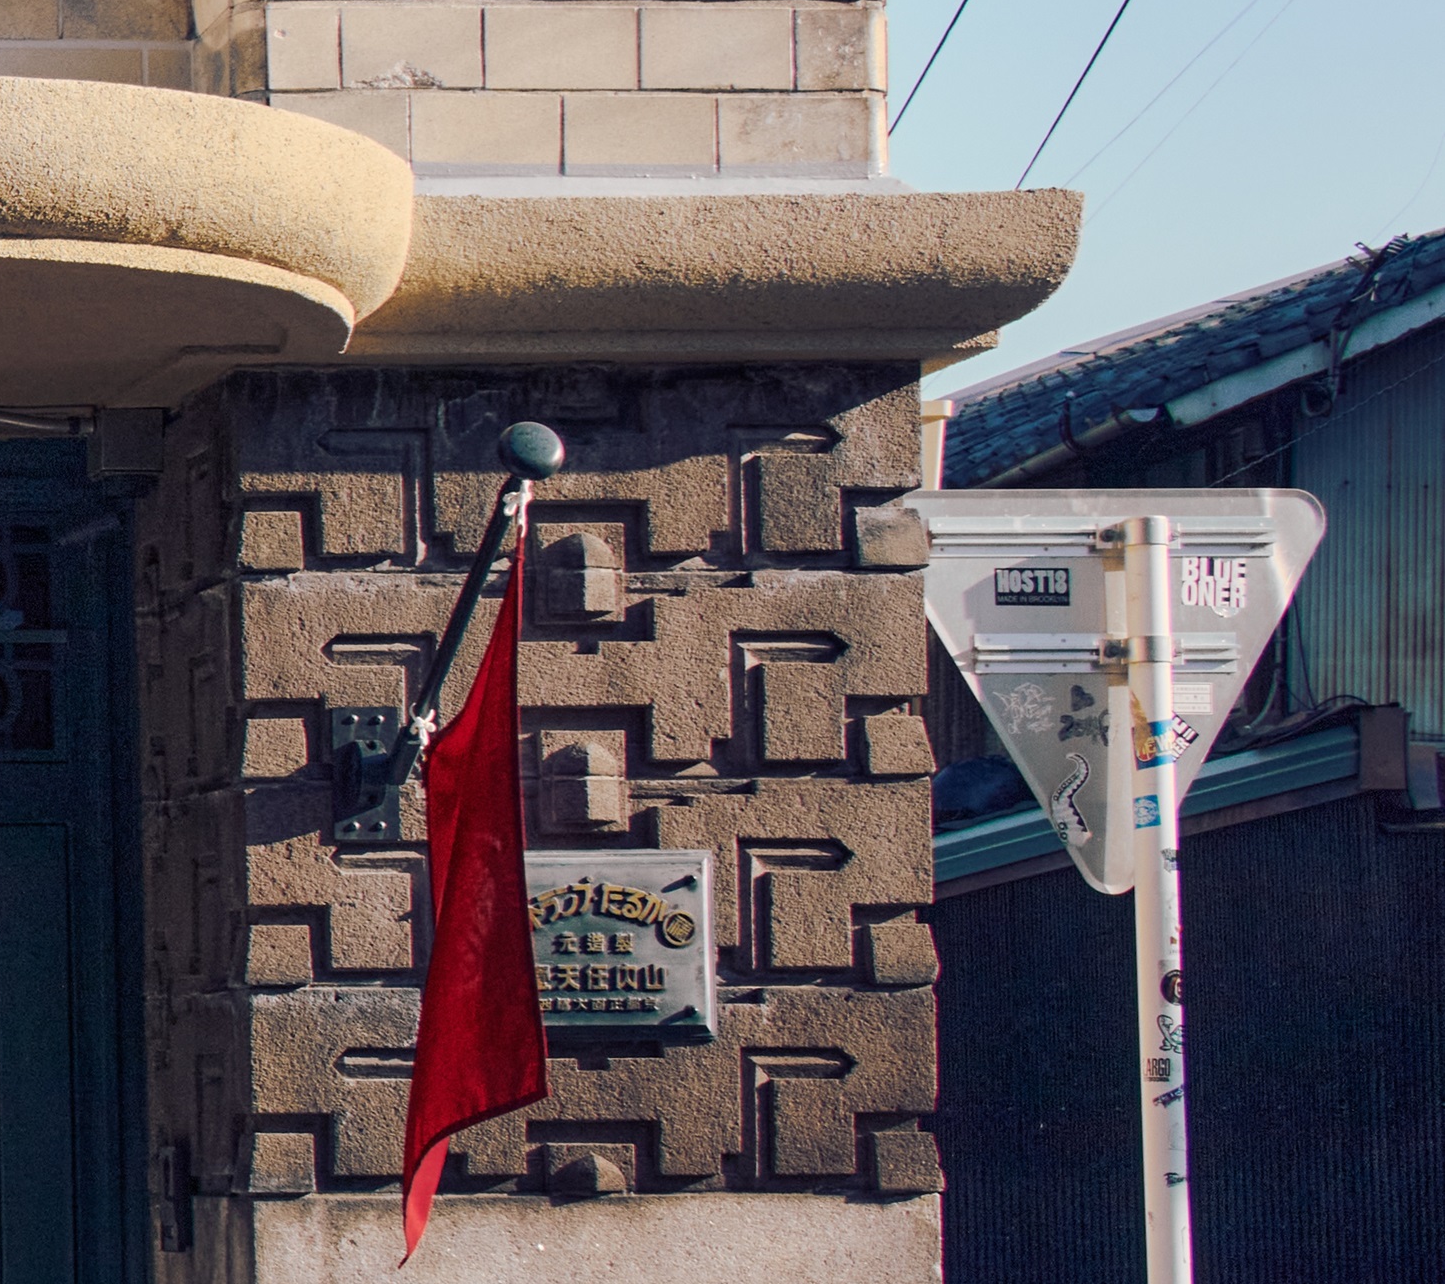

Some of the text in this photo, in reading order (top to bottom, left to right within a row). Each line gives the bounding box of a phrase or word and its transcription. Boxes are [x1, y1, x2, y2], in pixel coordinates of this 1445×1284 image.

[1182, 557, 1246, 581] BLUE
[996, 569, 1068, 594] HOST18
[1181, 580, 1245, 607] ONER
[1019, 595, 1027, 603] IN
